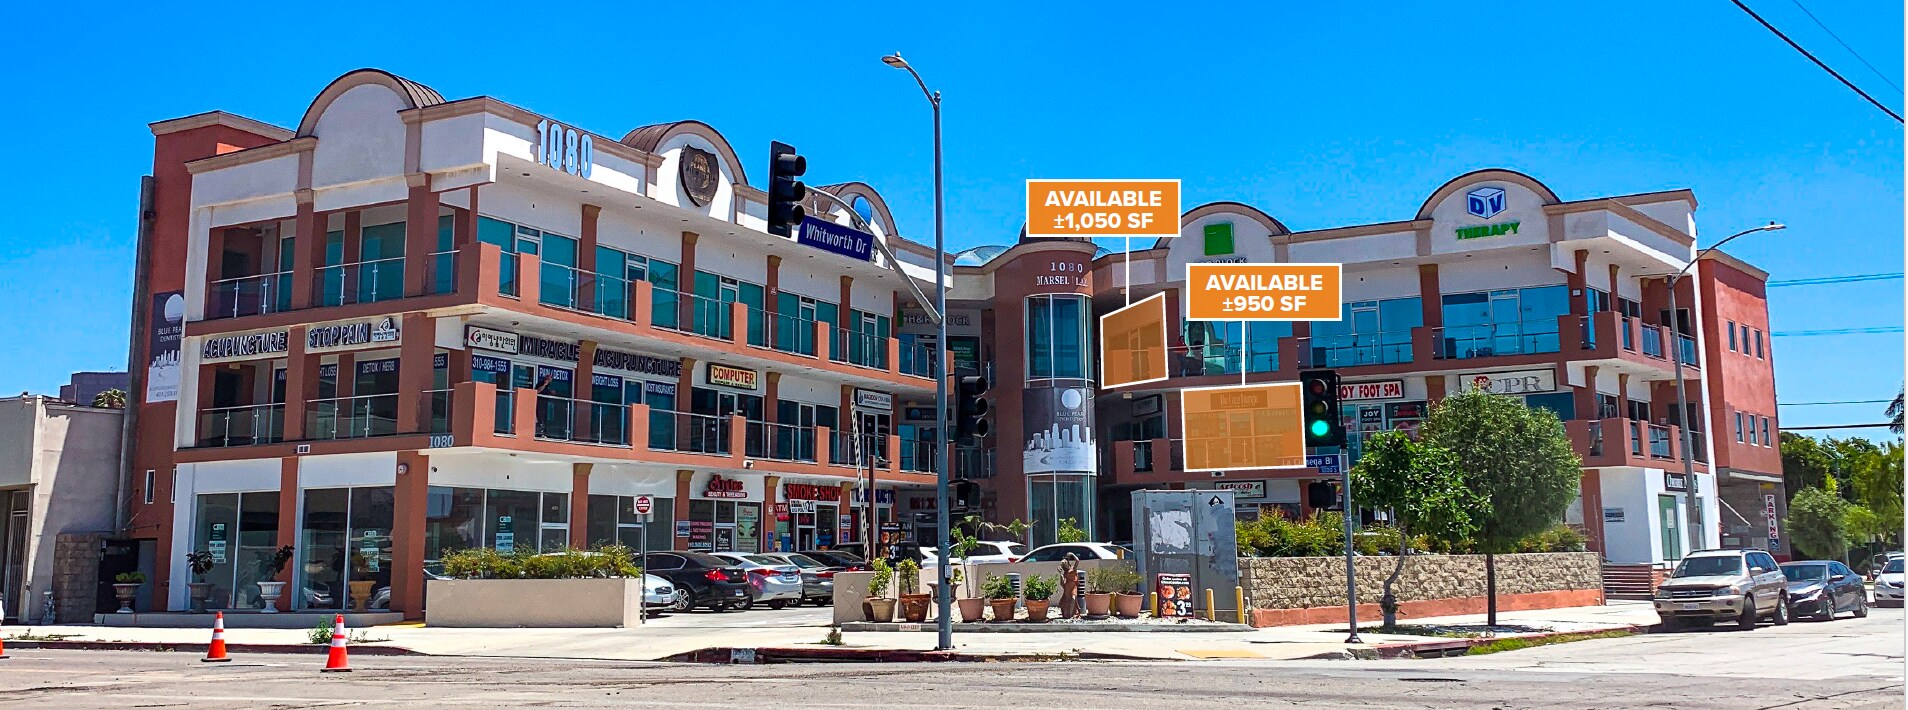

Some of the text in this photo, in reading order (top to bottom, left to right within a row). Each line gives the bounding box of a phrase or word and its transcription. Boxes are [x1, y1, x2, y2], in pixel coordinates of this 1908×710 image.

[537, 120, 592, 180] 1080
[806, 223, 853, 250] Whitworth
[855, 238, 867, 254] Dr
[1455, 222, 1520, 240] THERAPY
[1050, 262, 1083, 273] 1080
[1037, 275, 1069, 286] MARSEL
[309, 322, 370, 349] STOP PAIN
[203, 331, 289, 359] ACUPUNCTURE
[521, 337, 581, 360] MIRACLE
[472, 360, 507, 373] 310-984-1555
[595, 348, 682, 377] ACUPUNCTURE
[553, 370, 569, 381] DETOX
[608, 377, 619, 388] LOSS
[1341, 382, 1400, 399] OY FOOT SPA
[1489, 376, 1541, 393] CPR
[1363, 410, 1379, 418] JOY
[429, 434, 454, 448] 1080
[1293, 456, 1323, 468] Cinega
[787, 484, 818, 501] SMOKE
[1767, 495, 1777, 538] PARKING
